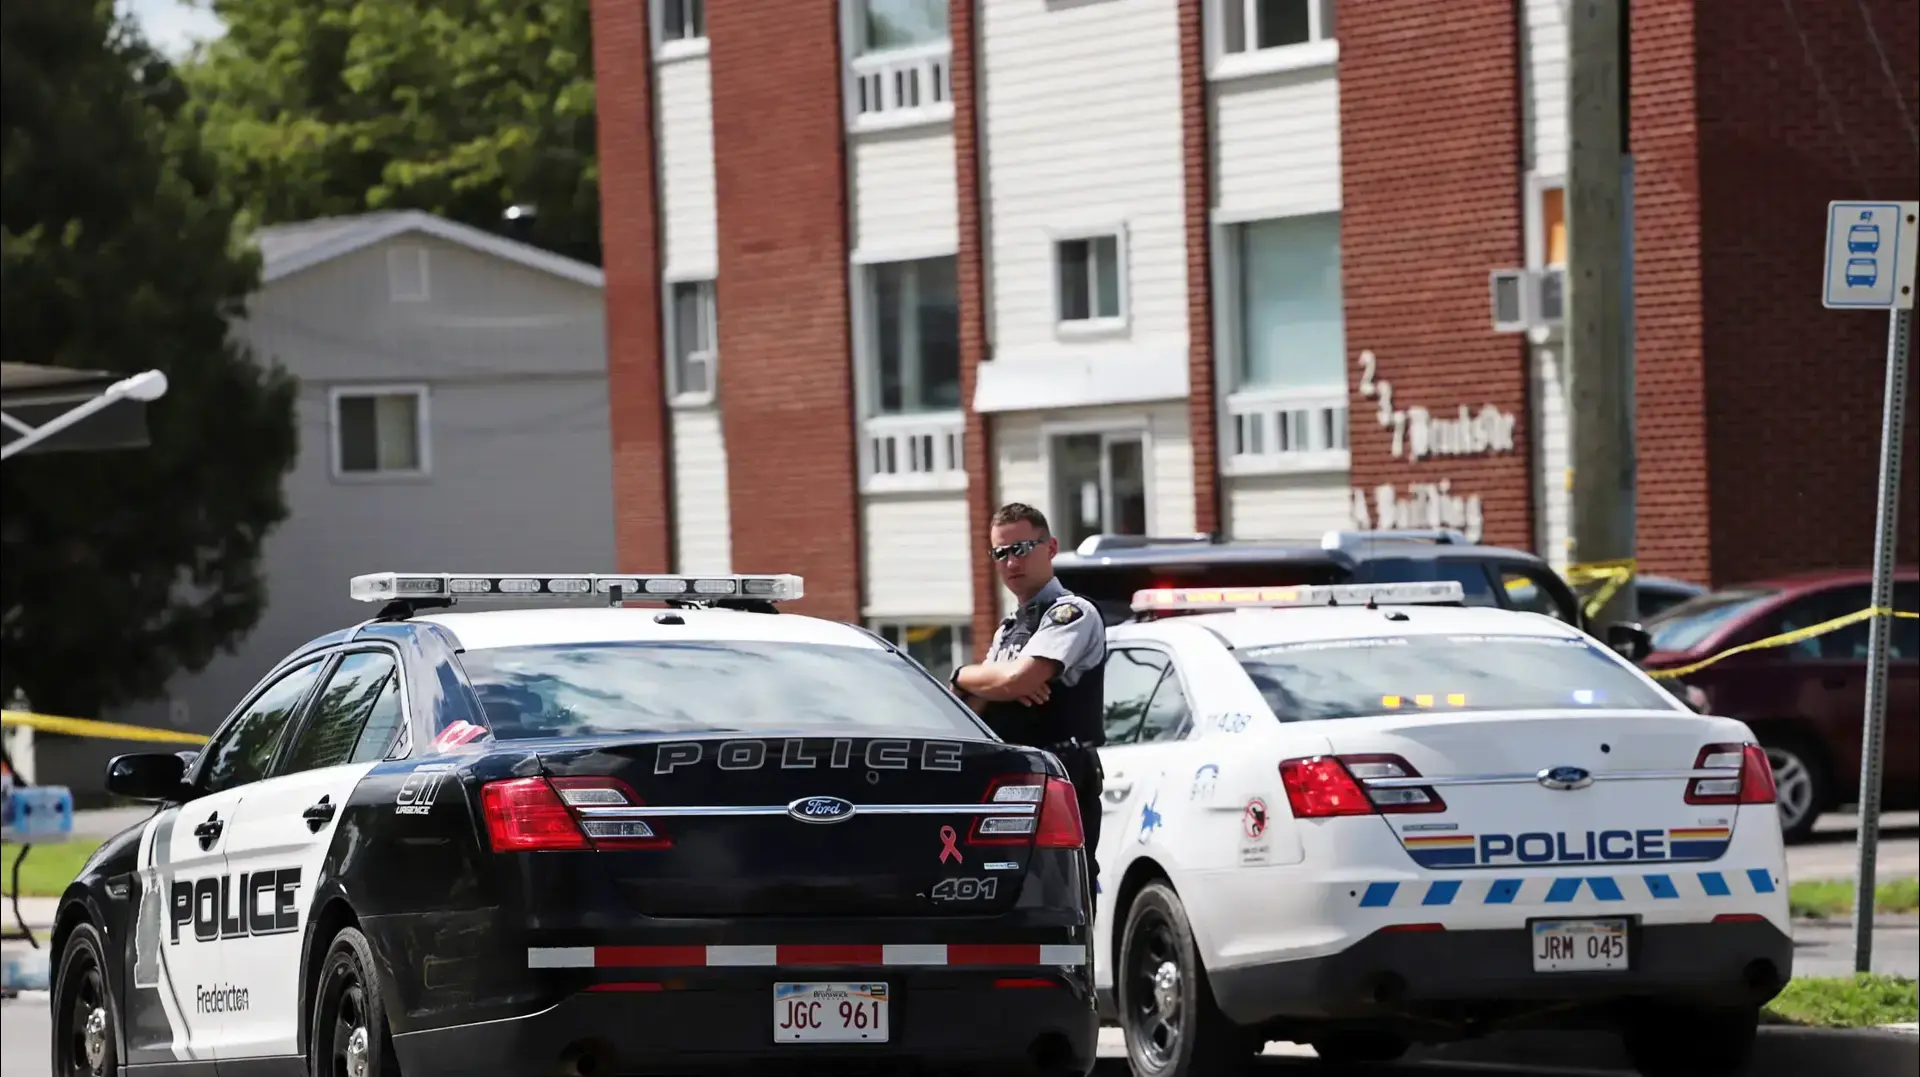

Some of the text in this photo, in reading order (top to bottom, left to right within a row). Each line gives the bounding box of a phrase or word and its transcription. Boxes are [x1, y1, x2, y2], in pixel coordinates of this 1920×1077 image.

[654, 738, 963, 775] POLICE
[396, 771, 447, 806] 911
[395, 805, 431, 815] URGENCE
[804, 799, 842, 816] Ford
[1480, 829, 1666, 864] POLICE
[931, 877, 999, 900] 401
[170, 865, 303, 946] POLICE
[1538, 934, 1624, 960] JRM 045
[196, 981, 250, 1014] Fredericton
[780, 1001, 879, 1029] JGC 961
